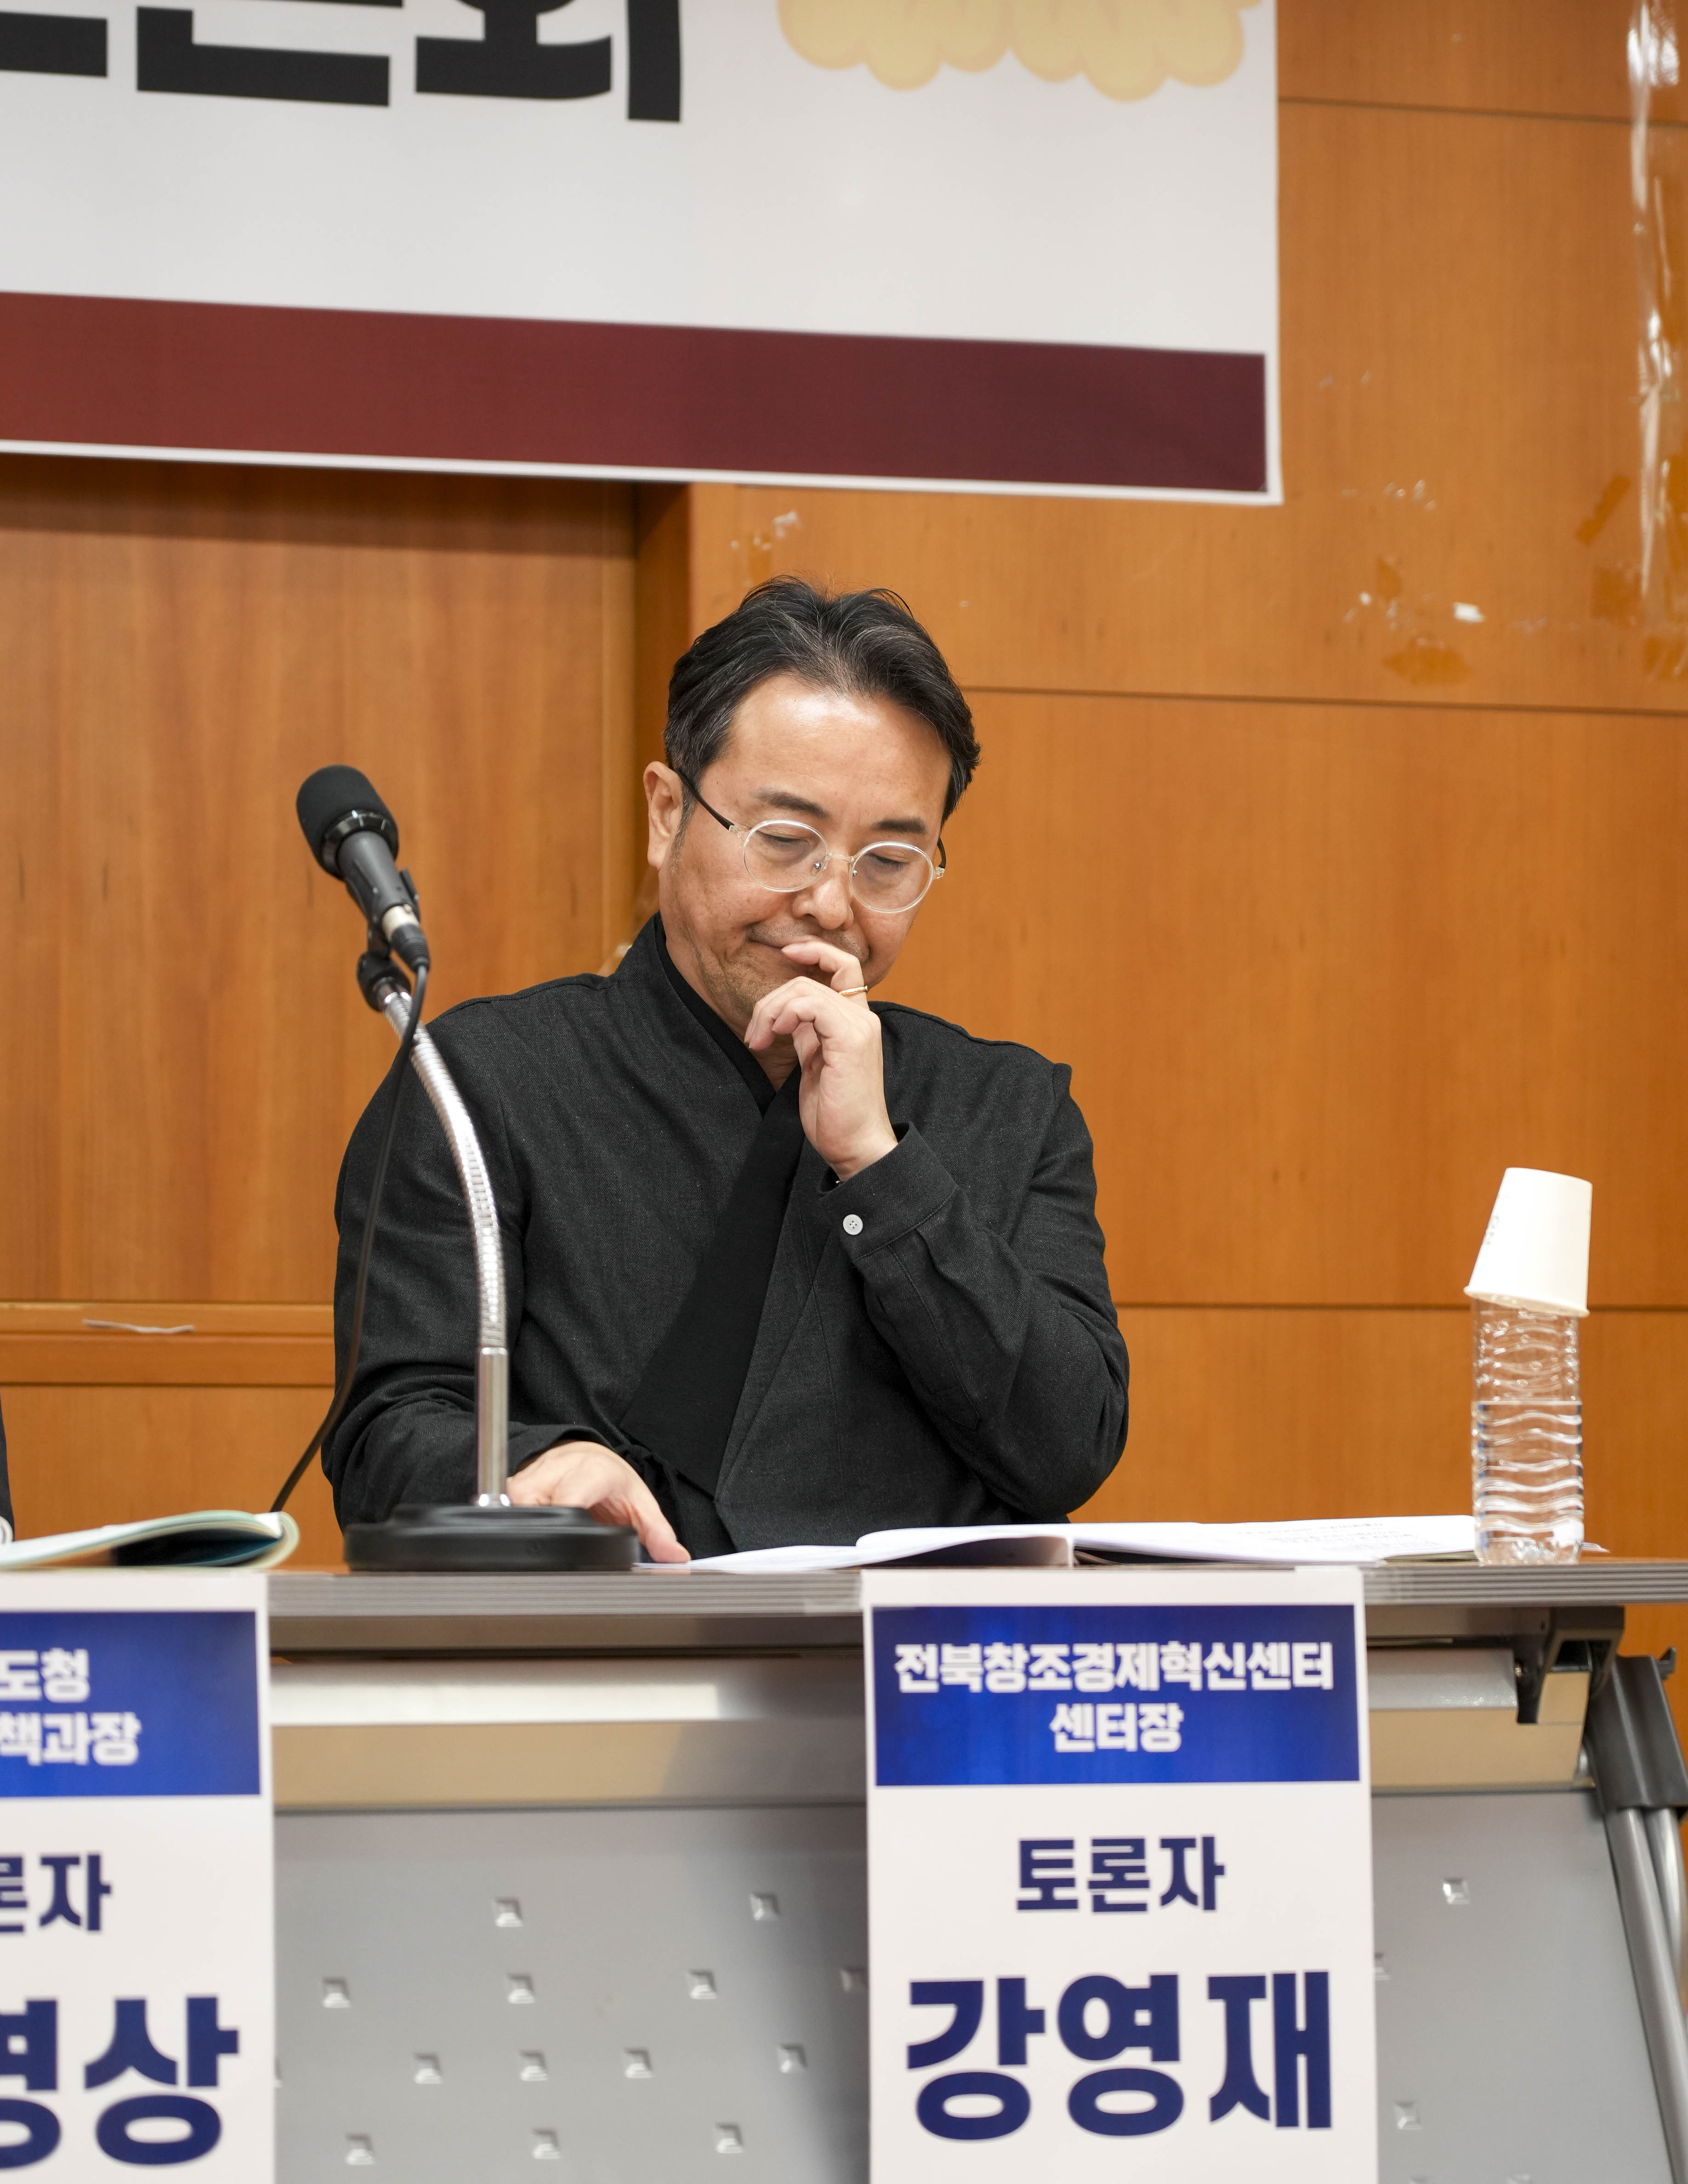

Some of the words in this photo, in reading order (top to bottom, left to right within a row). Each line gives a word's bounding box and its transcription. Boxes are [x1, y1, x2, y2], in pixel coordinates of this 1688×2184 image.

[0, 1648, 90, 1702] 도청
[894, 1640, 1334, 1694] 전북창조경제혁신센터
[1050, 1702, 1184, 1753] 센터장
[1017, 1836, 1225, 1913] 토론자
[907, 1971, 1332, 2141] 강영재
